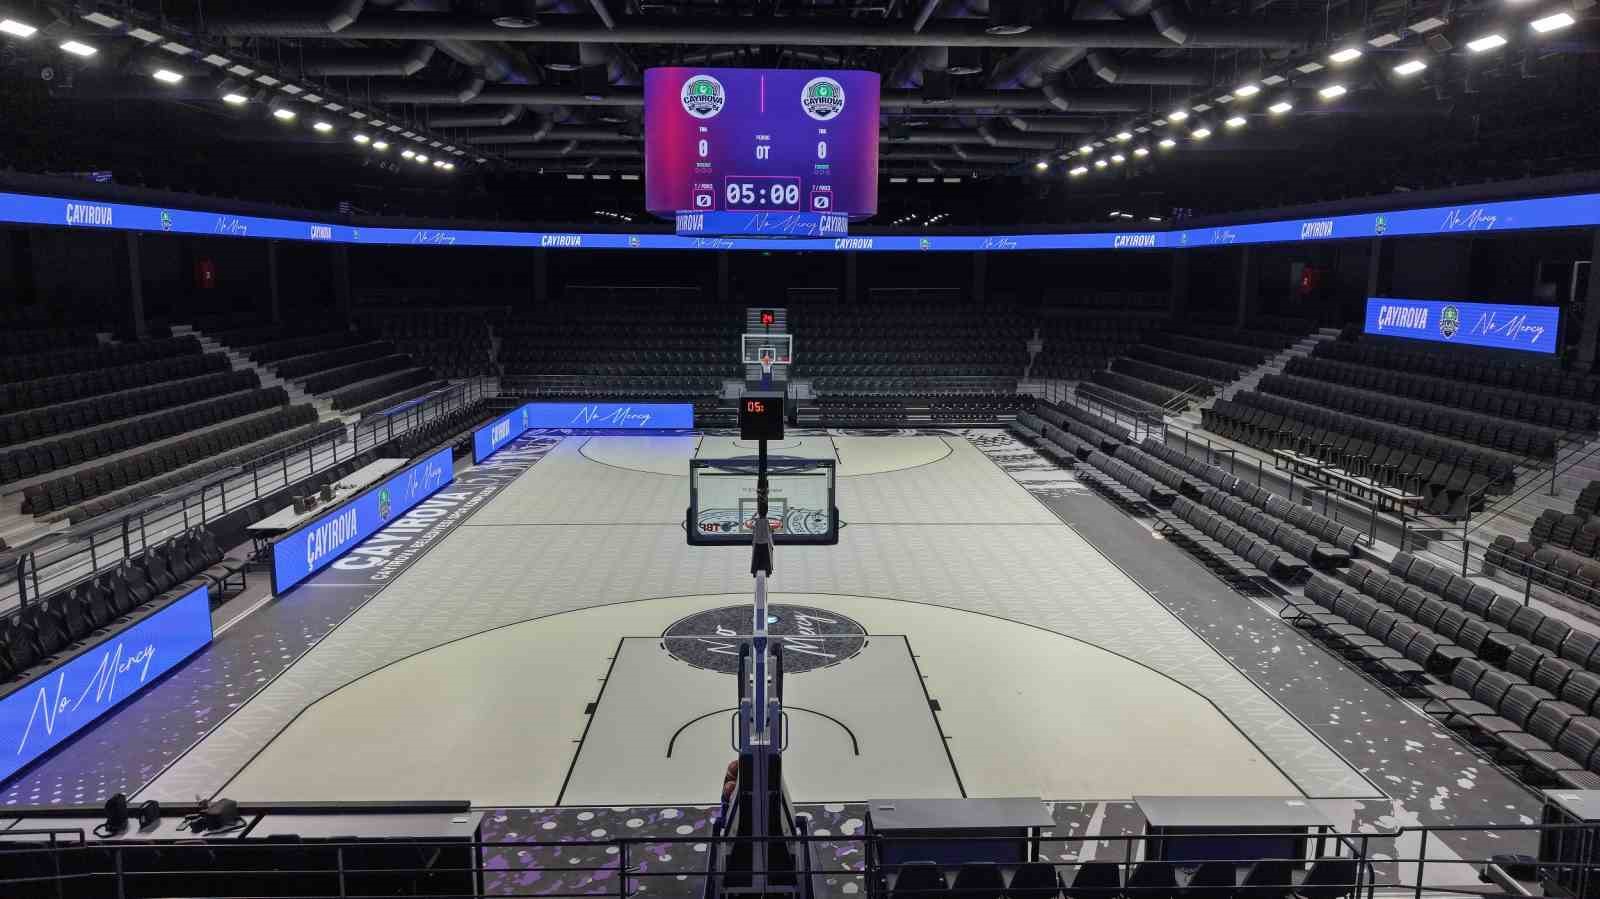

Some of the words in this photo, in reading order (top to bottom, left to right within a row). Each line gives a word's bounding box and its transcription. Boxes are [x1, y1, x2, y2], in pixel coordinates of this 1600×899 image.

[699, 140, 708, 157] 0
[817, 141, 827, 159] 0
[726, 184, 799, 204] 05:00
[66, 203, 112, 225] ÇAYIROVA
[1378, 305, 1428, 330] ÇAYIROVA
[1471, 311, 1497, 336] No
[570, 405, 599, 425] No
[307, 508, 358, 572] ÇAYIROVA
[331, 491, 473, 569] ÇAYIROVA
[697, 624, 740, 656] No
[783, 610, 839, 658] Mercy
[16, 672, 71, 756] No
[71, 643, 156, 712] Mercy
